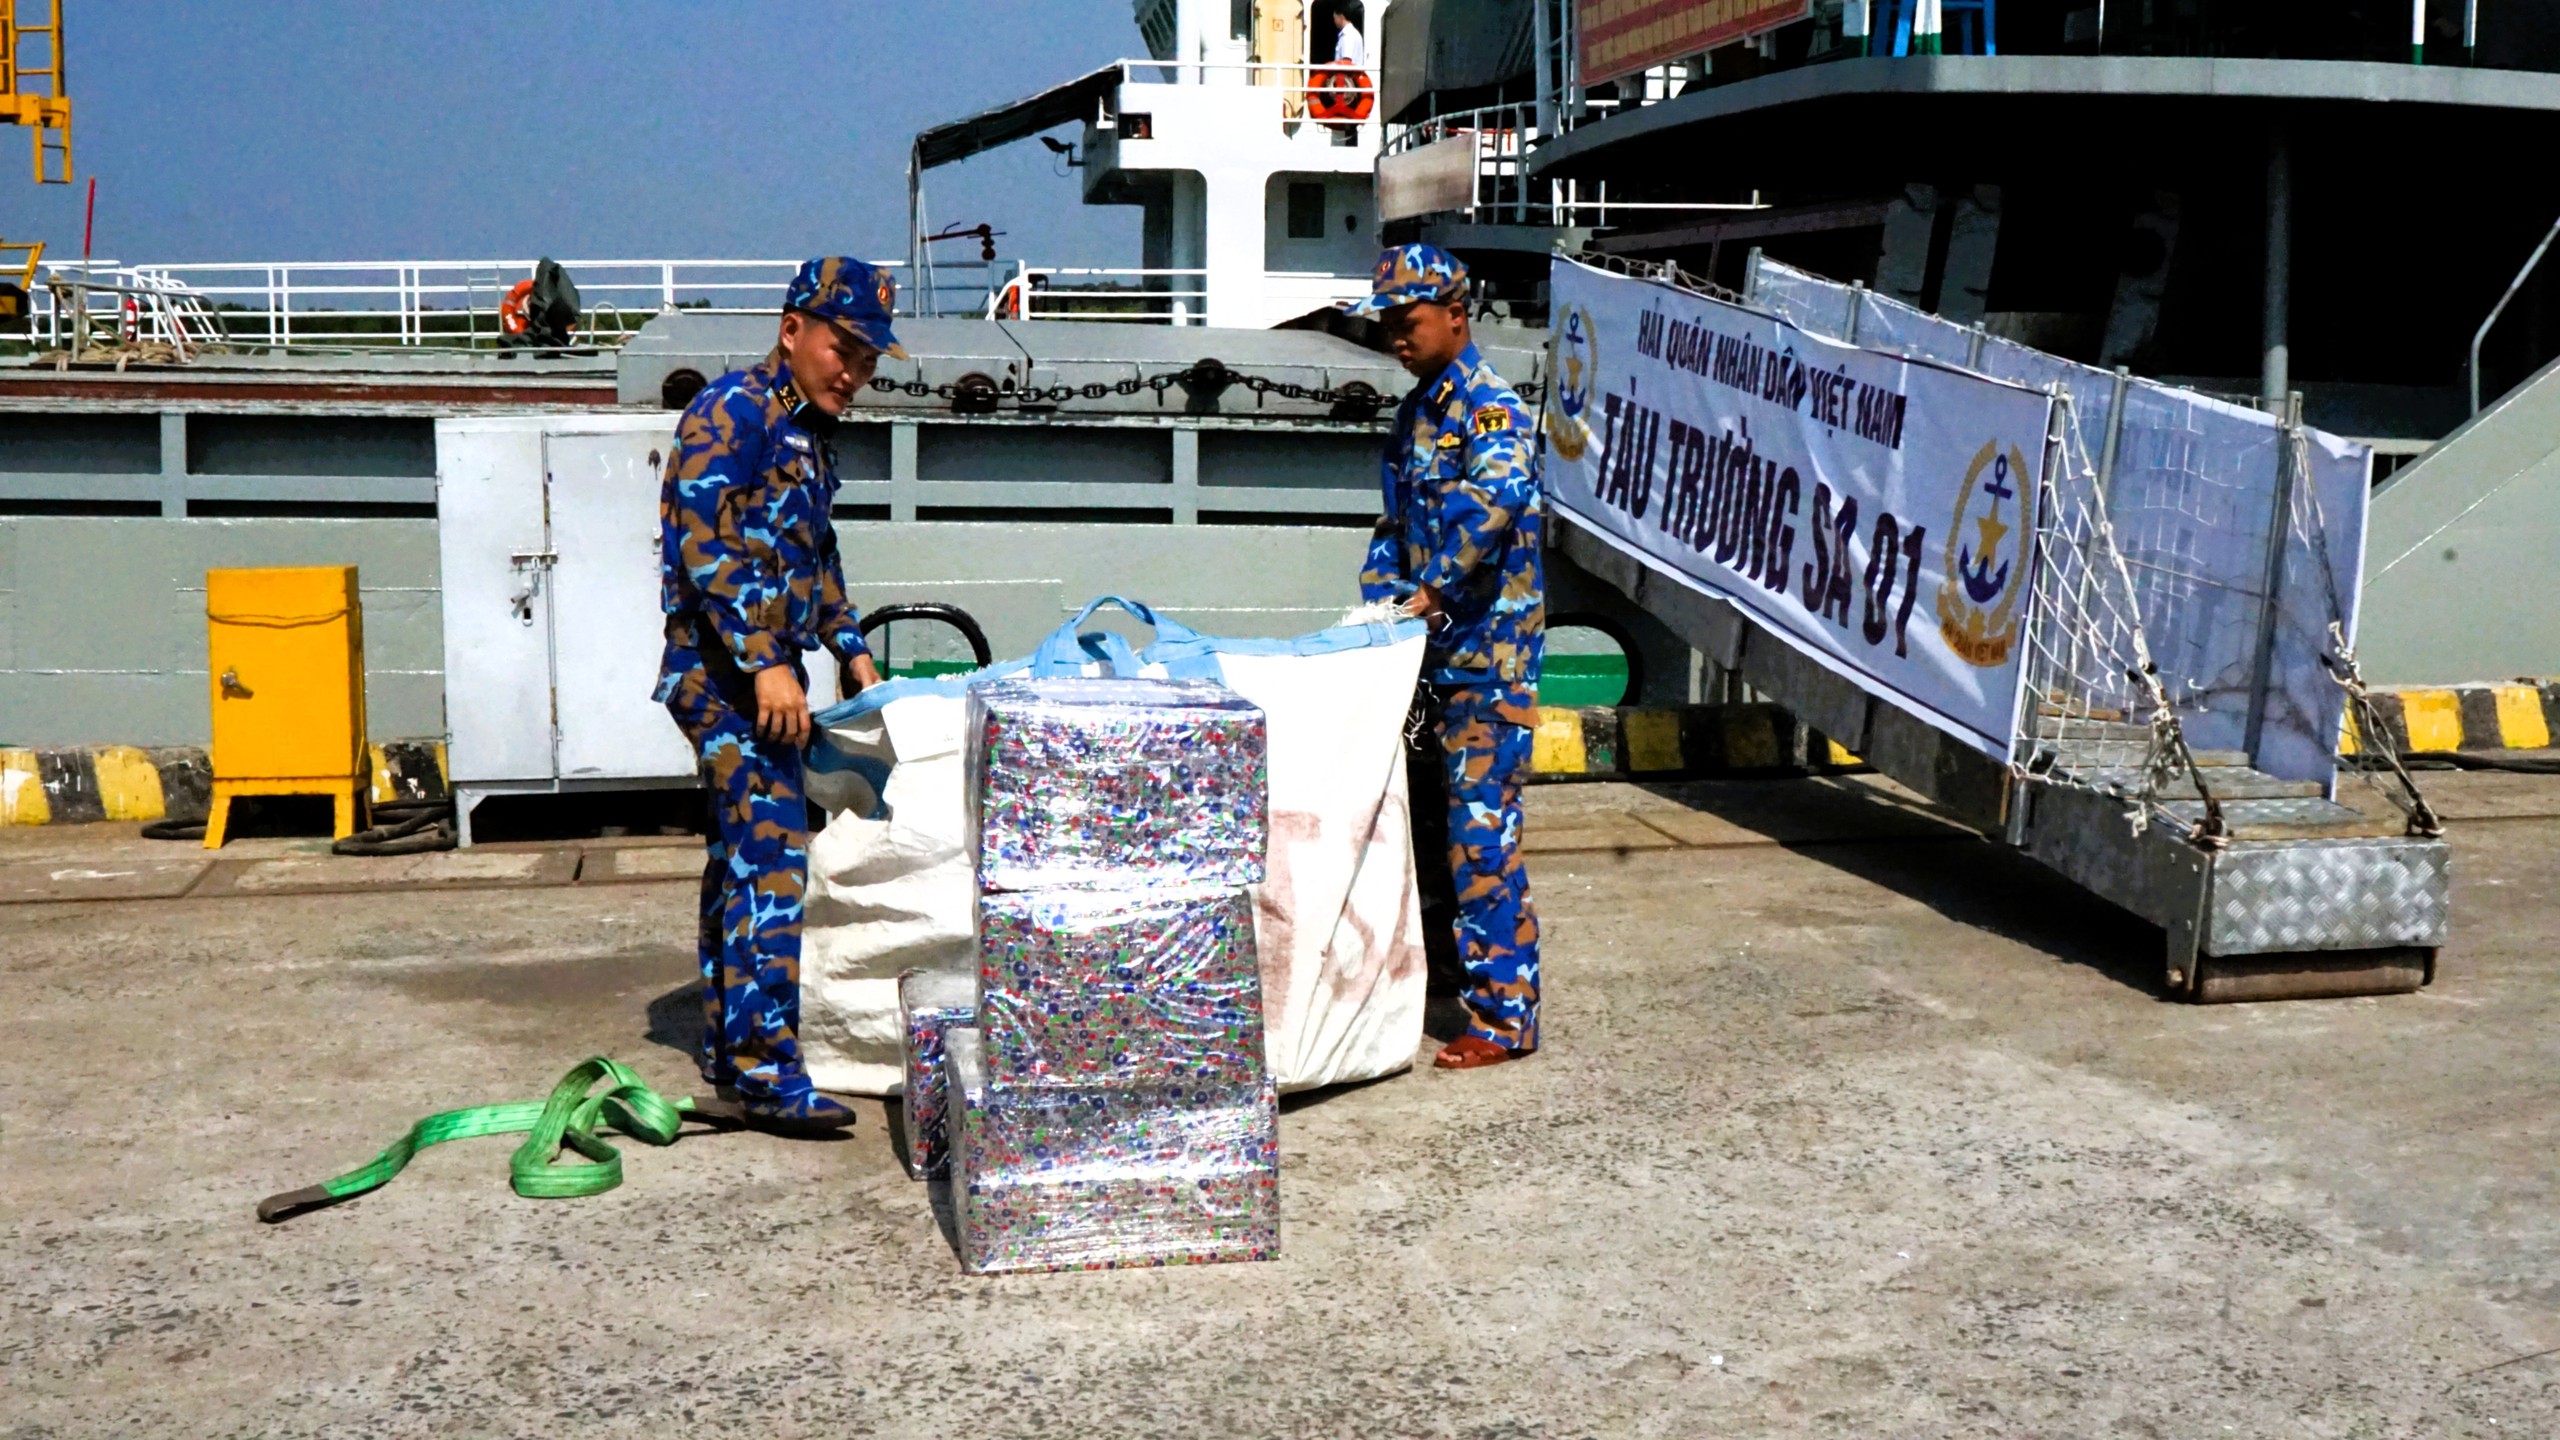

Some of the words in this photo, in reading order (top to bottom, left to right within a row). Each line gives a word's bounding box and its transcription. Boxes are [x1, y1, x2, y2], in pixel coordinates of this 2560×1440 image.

[1666, 316, 1714, 377] QUÂN
[1713, 332, 1764, 396] NHÂN
[1763, 346, 1807, 412] DÂN
[1810, 364, 1856, 437] VIỆT
[1855, 383, 1907, 450] NAM
[1595, 376, 1660, 519] TÀU
[1660, 416, 1800, 594] TRƯỜNG
[1802, 482, 1858, 629] SA
[1863, 512, 1926, 659] 01
